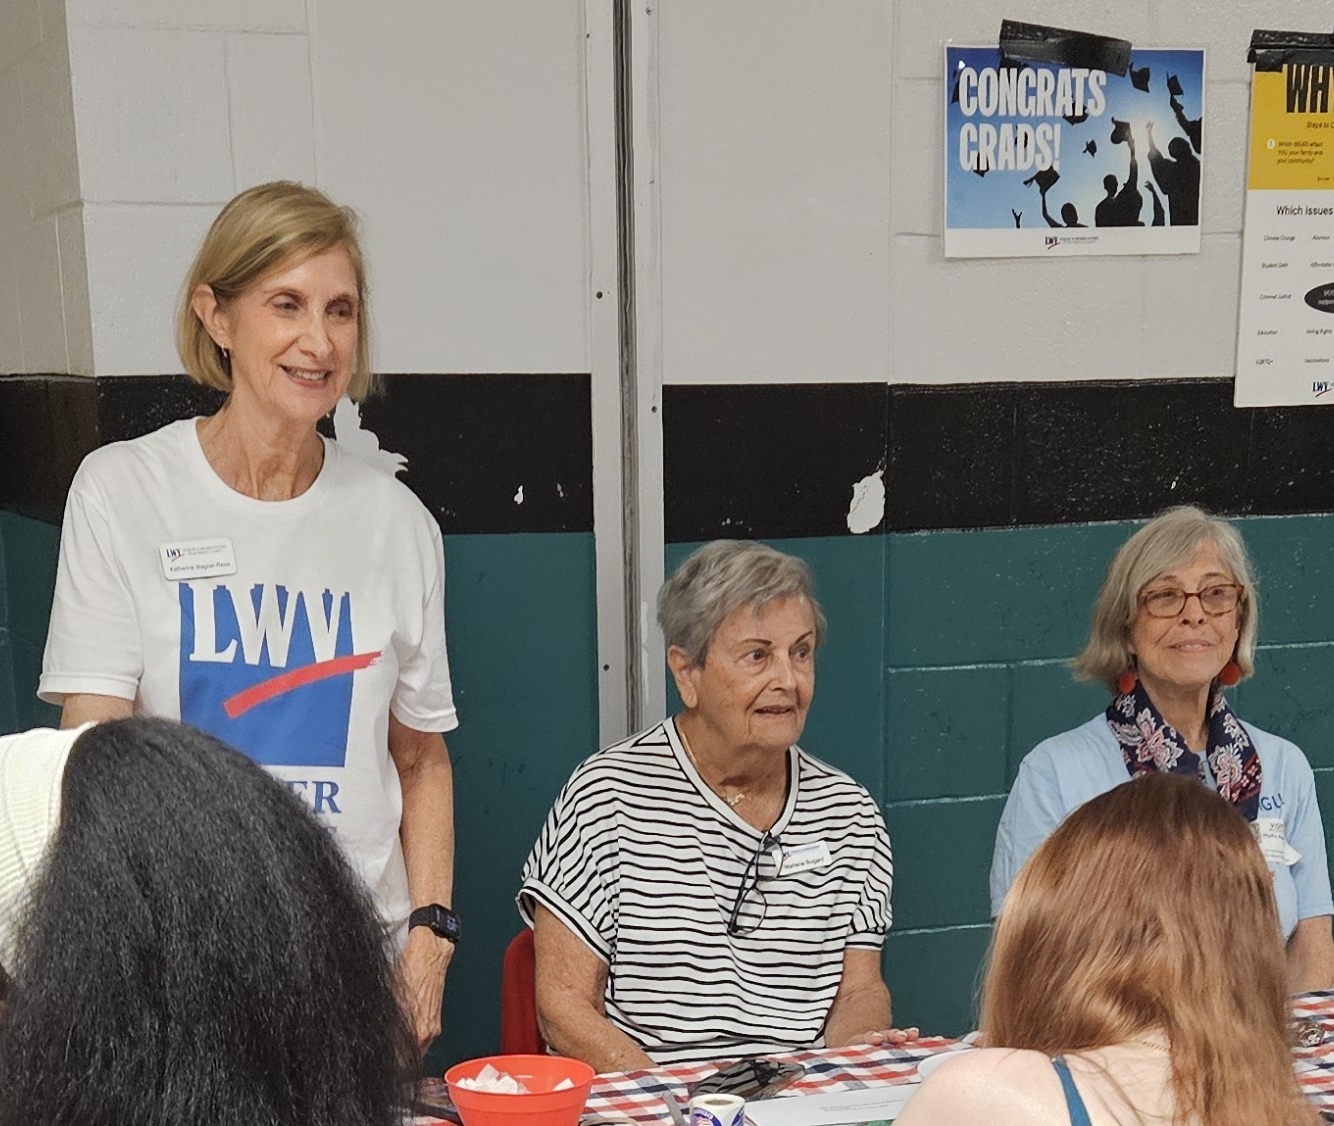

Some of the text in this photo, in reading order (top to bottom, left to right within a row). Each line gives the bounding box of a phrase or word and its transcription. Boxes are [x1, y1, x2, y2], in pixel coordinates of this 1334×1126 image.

[958, 67, 1107, 117] CONGRATS
[959, 122, 1062, 172] GRADS!
[1277, 206, 1303, 216] Which
[1305, 205, 1333, 215] issues
[188, 581, 350, 668] LWV
